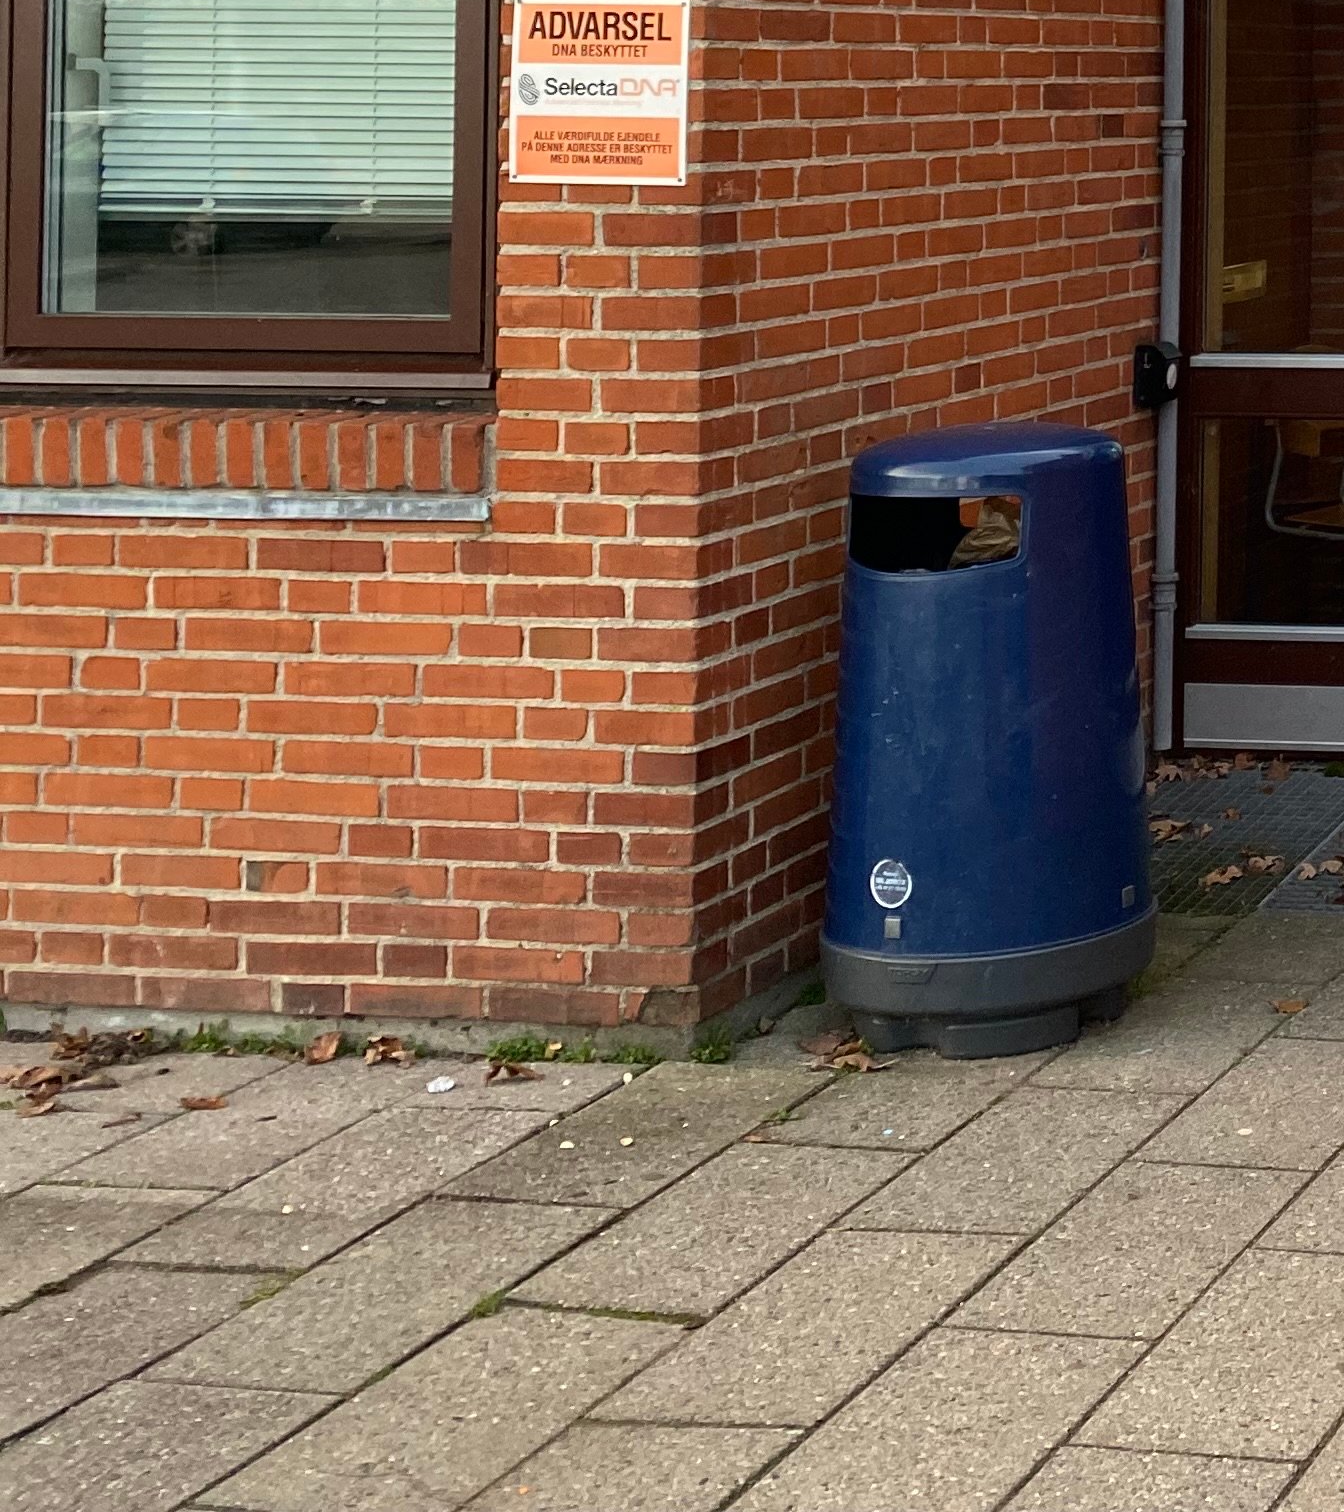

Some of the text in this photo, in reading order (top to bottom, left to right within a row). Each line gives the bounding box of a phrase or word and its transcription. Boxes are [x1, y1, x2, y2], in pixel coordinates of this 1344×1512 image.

[528, 11, 672, 42] ADVARSEL
[552, 44, 648, 58] DNA BESKYTTET
[534, 131, 660, 143] ALLE VÆRDIFULDE EJENDELE
[521, 141, 672, 155] PÅ DENNE ADRESSE ER BESKYTTET
[550, 154, 643, 166] MED DNA MÆRKNING
